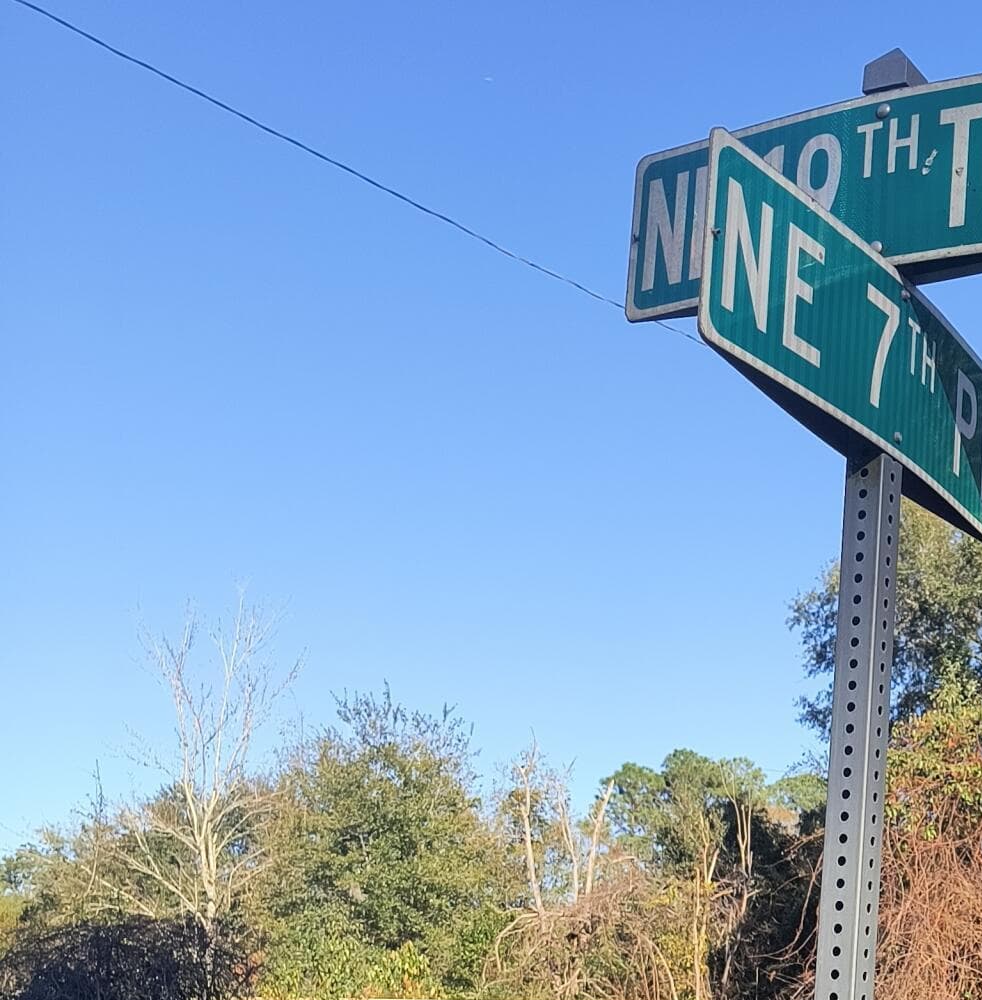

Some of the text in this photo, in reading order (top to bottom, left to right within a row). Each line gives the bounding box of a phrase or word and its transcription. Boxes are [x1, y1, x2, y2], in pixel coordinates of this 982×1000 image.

[763, 113, 921, 212] 9TH
[720, 175, 826, 368] NE
[867, 282, 937, 409] 7TH
